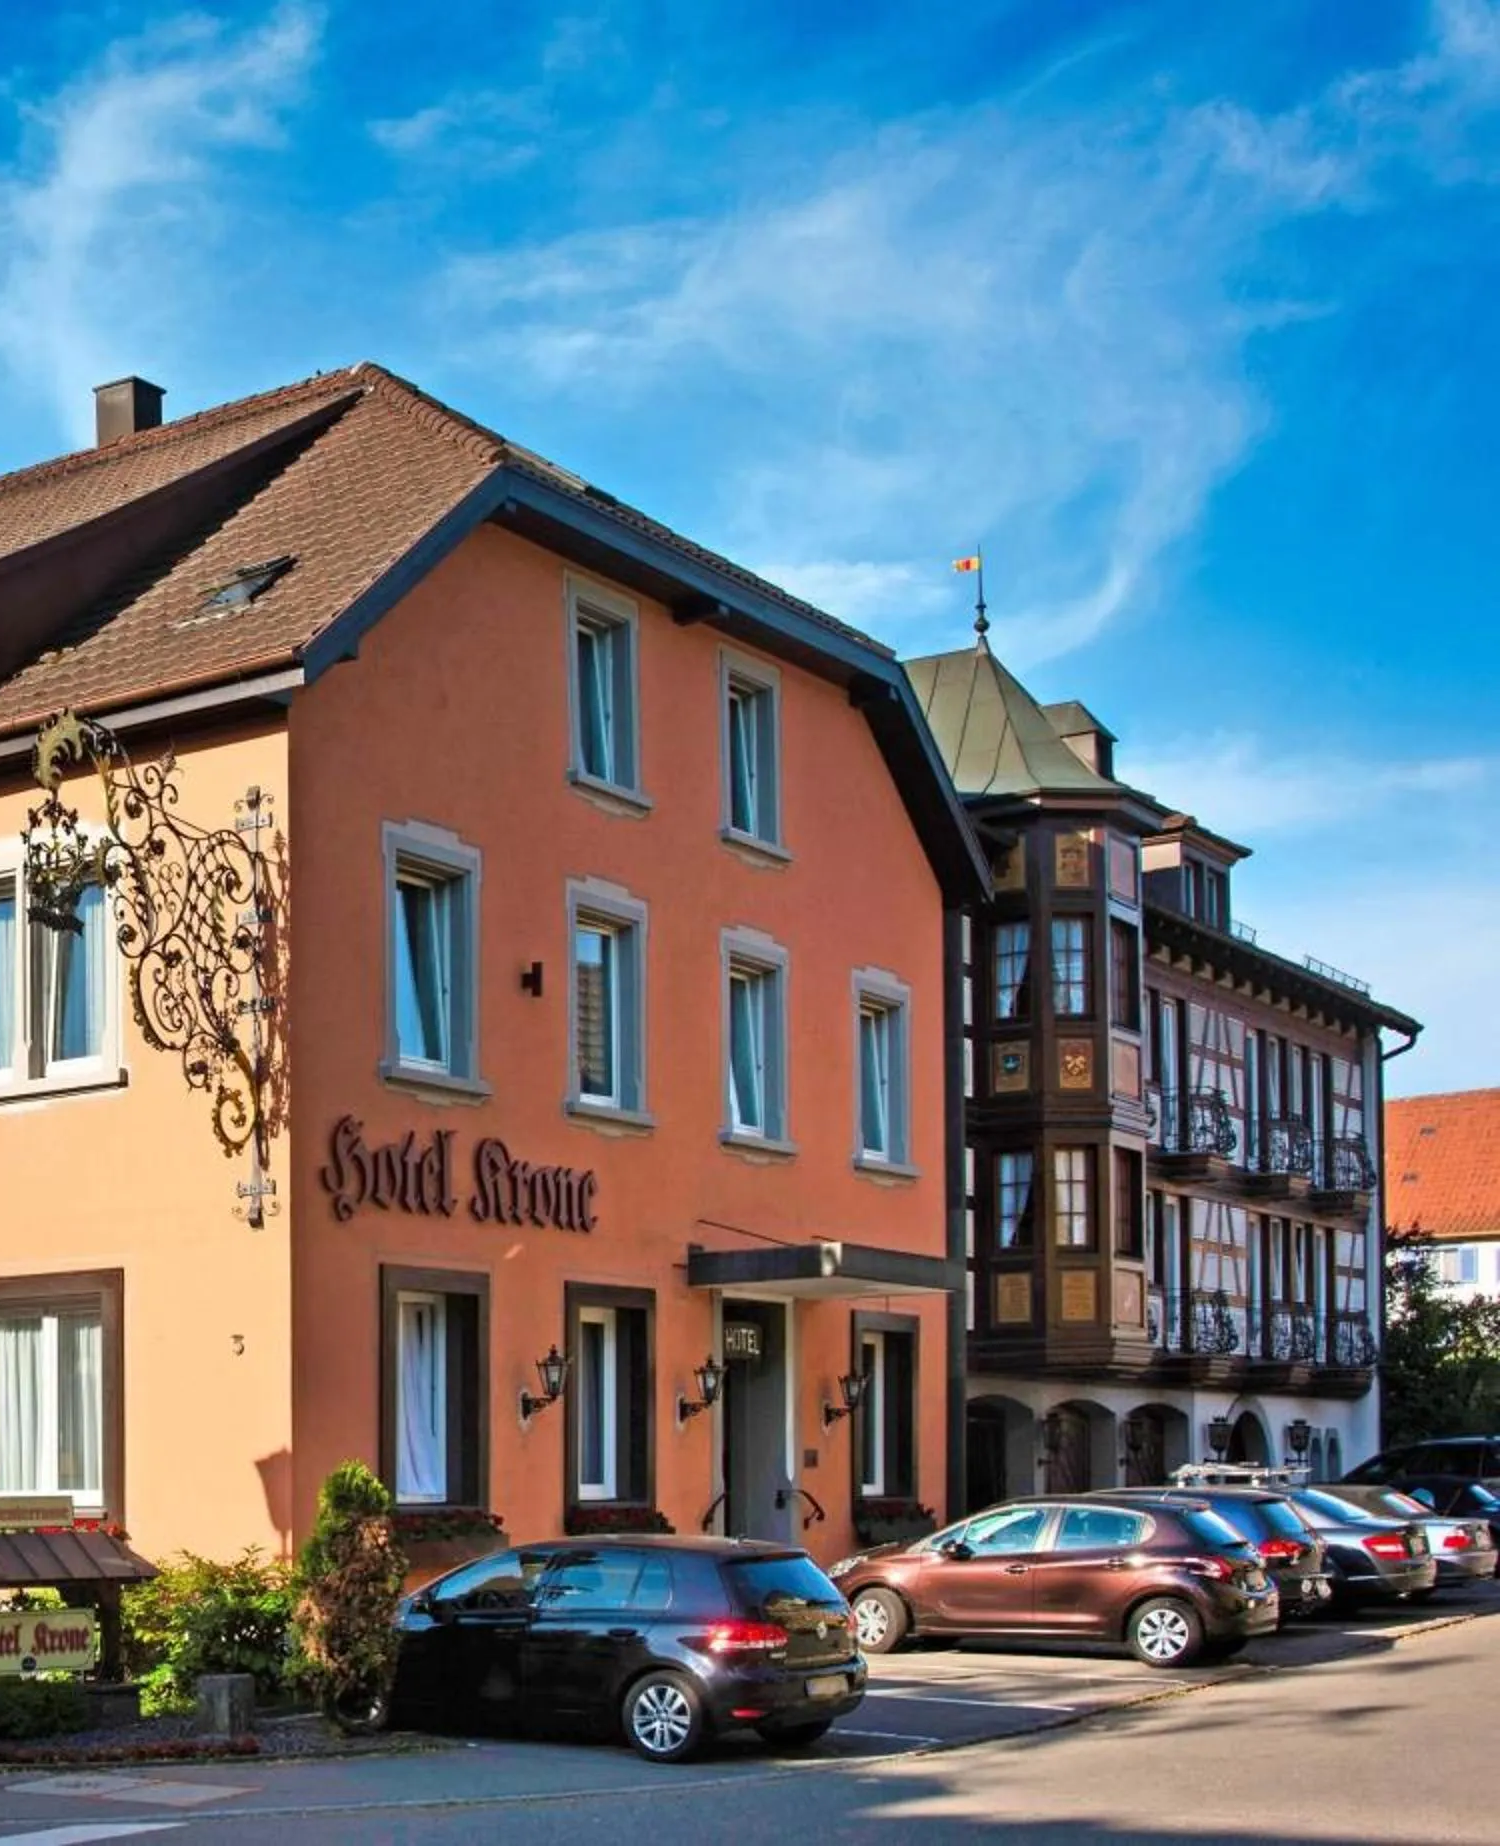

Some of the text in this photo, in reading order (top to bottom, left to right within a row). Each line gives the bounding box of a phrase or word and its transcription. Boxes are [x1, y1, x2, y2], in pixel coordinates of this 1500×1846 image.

[320, 1114, 598, 1233] Hotel Krone
[724, 1327, 761, 1354] HOTEL
[31, 1622, 89, 1655] Krone
